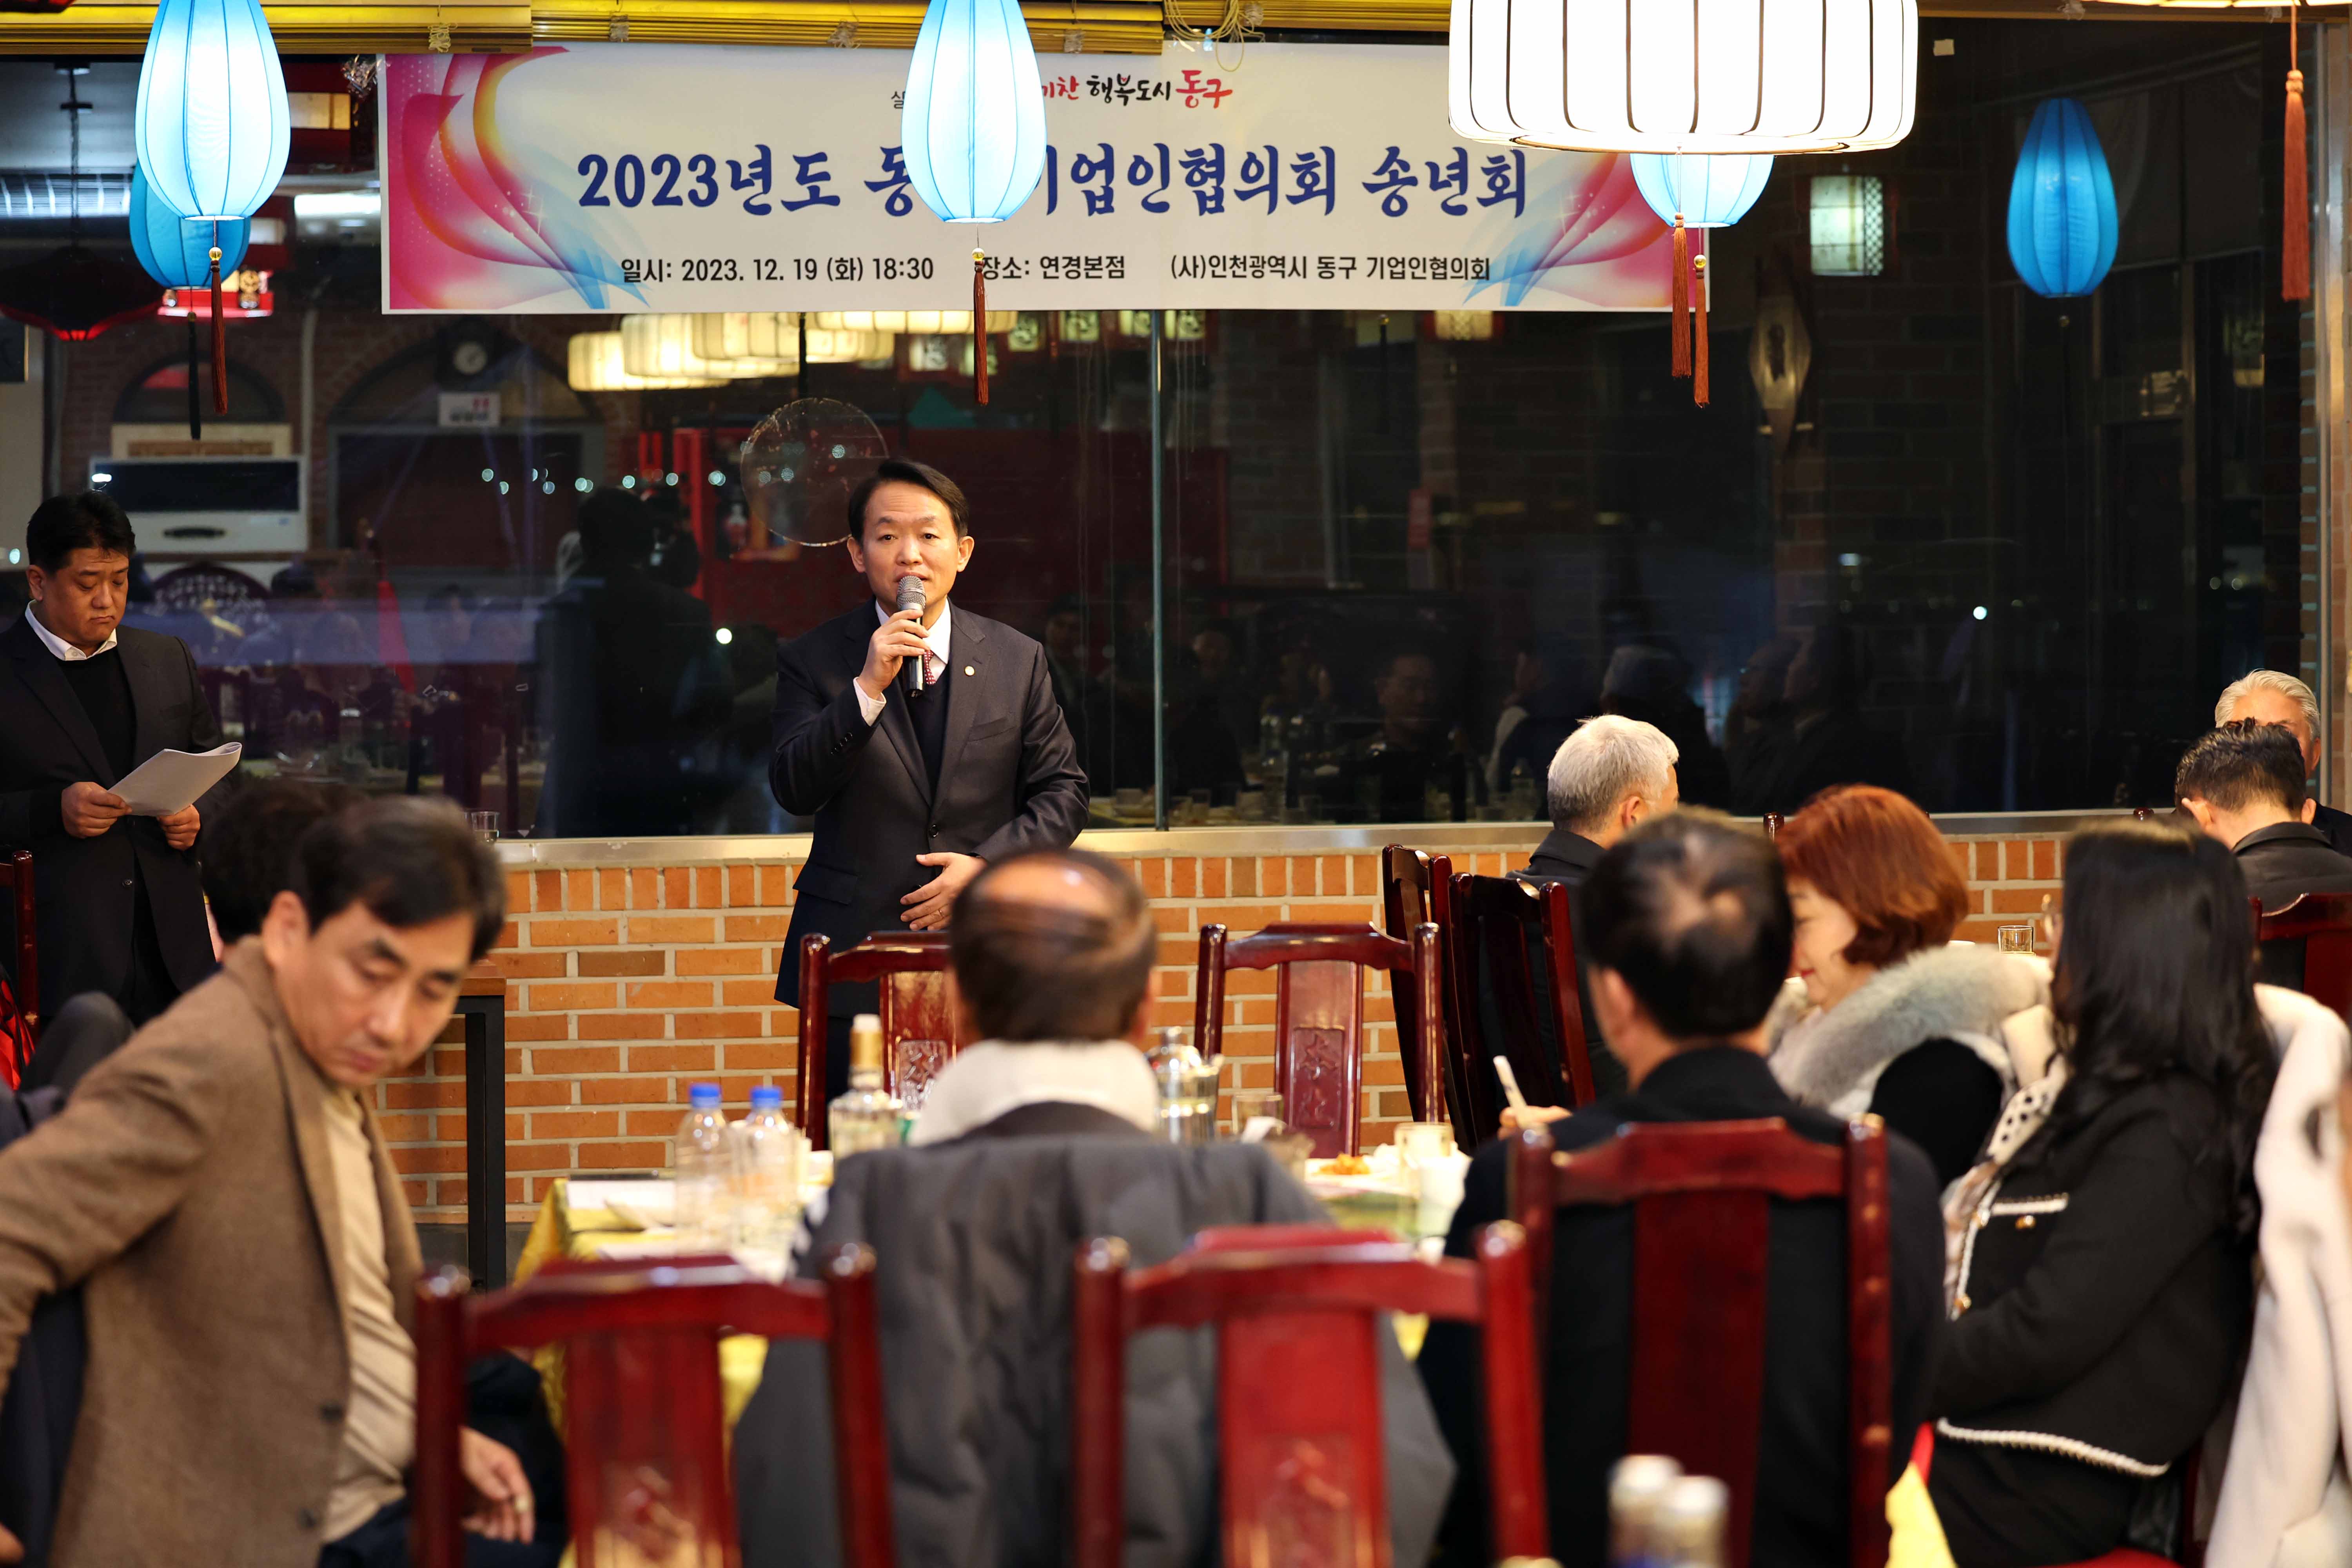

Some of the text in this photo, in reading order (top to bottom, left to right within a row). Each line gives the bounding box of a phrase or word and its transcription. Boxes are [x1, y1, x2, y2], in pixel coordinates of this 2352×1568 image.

[1042, 75, 1080, 100] 기찬
[1086, 73, 1171, 106] 행복도시
[1176, 69, 1234, 109] 동구
[578, 143, 841, 216] 2023년도
[864, 145, 913, 217] 동
[1362, 145, 1525, 218] 송년회
[621, 257, 933, 283] 일시: 2023. 12. 19 (화) 18:30
[982, 256, 1125, 280] 장소: 연경본점
[1171, 255, 1490, 281] (사)인천광역시 동구 기업인협의회
